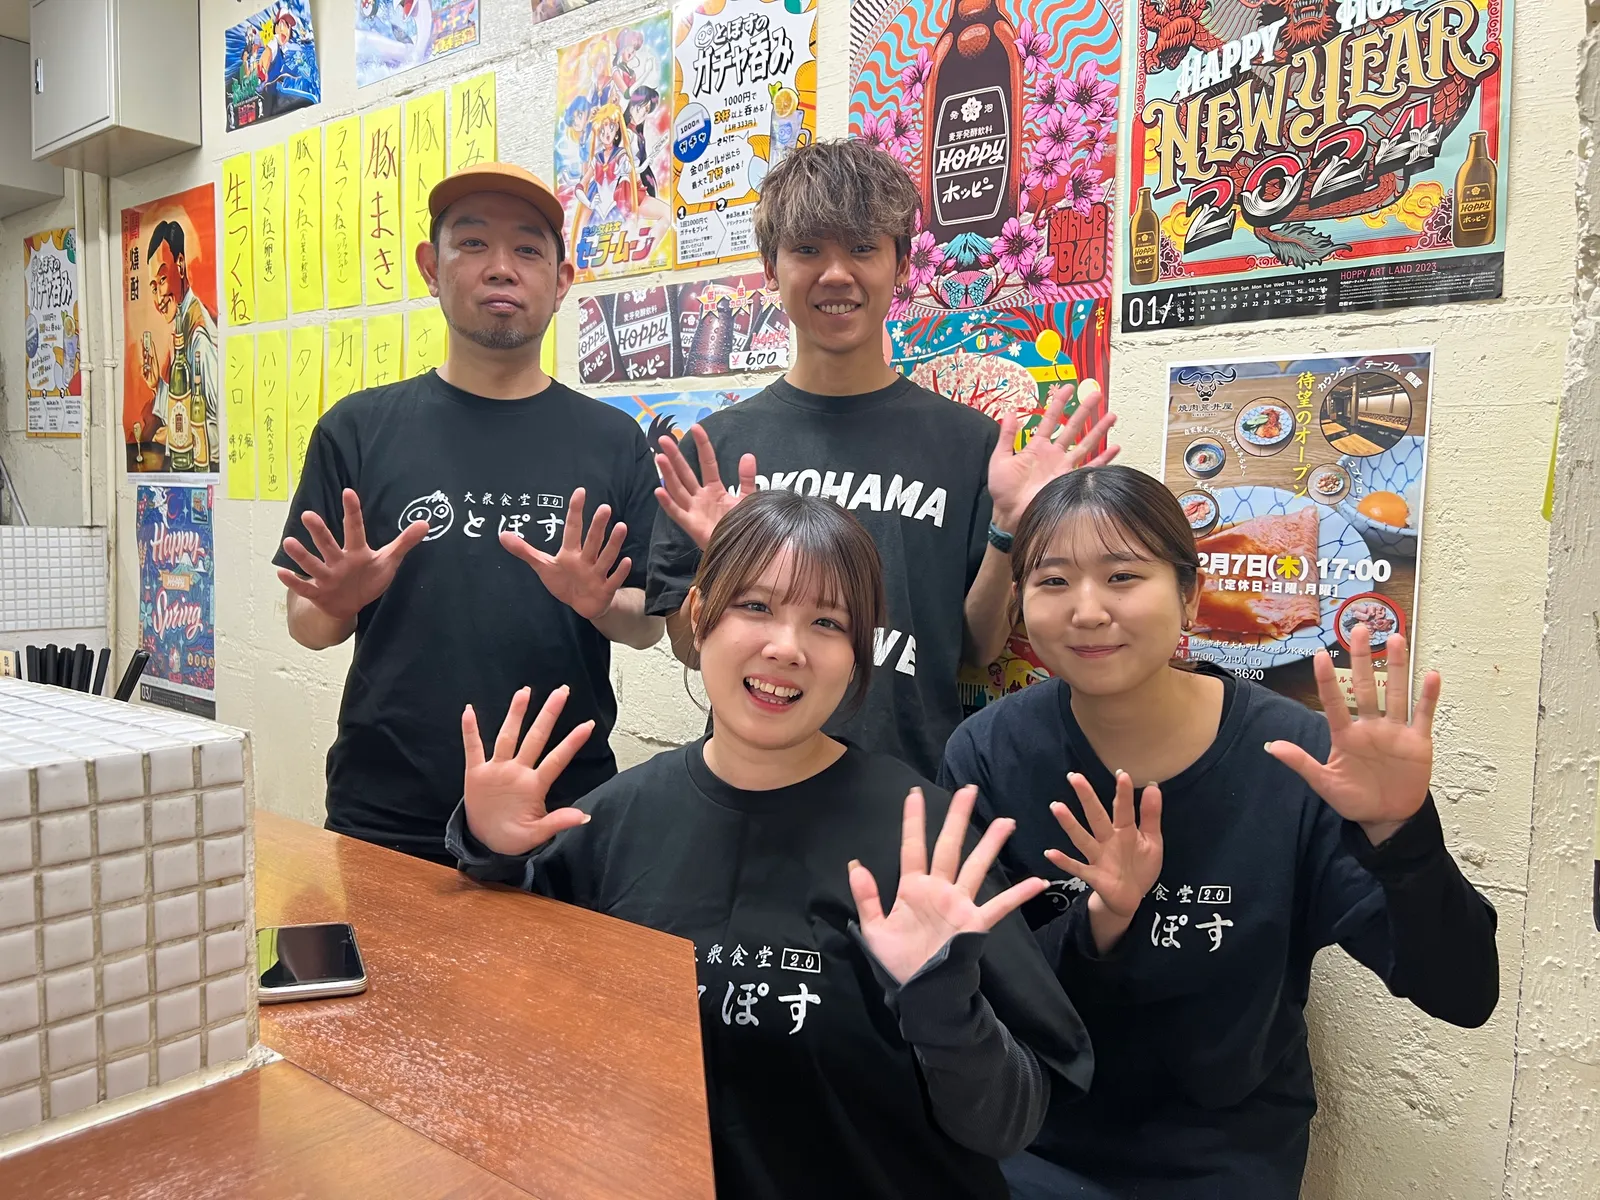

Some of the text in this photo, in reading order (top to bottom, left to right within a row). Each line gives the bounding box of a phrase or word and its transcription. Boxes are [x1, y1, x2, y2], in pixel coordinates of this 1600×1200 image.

[692, 26, 794, 98] ガチャ呑み
[1177, 16, 1287, 100] HAPPY
[724, 91, 757, 106] 1000円で
[1142, 0, 1500, 197] NEW YEAR
[717, 135, 735, 146] さらに
[949, 125, 992, 142] 麦芽発酵飲料
[690, 148, 740, 176] 金のボールが出たら
[1184, 97, 1444, 256] 2024
[942, 177, 994, 203] ホッピー
[365, 124, 397, 290] 豚まき
[1463, 214, 1486, 225] ホッピー
[226, 172, 251, 322] 生つくね
[576, 227, 655, 269] セーラームーン
[1340, 269, 1368, 280] HOPPY
[1369, 266, 1386, 277] ART
[1388, 264, 1413, 275] LAND
[1416, 262, 1437, 273] 2023
[729, 299, 753, 308] カロリー
[579, 324, 606, 357] oppy
[231, 356, 244, 404] シロ
[583, 351, 607, 377] ホッピー
[626, 354, 665, 380] ホッピー
[1293, 371, 1316, 499] 待望のオープン
[463, 491, 531, 507] 大衆食堂
[728, 468, 947, 528] KOHAMA
[463, 510, 565, 542] とぽす
[150, 522, 206, 567] Happy
[1316, 557, 1392, 583] 17:00
[153, 587, 203, 640] Spring
[1150, 911, 1234, 952] ぽす
[694, 943, 817, 971] 衆食堂 2.0
[698, 981, 821, 1035] ぽす
